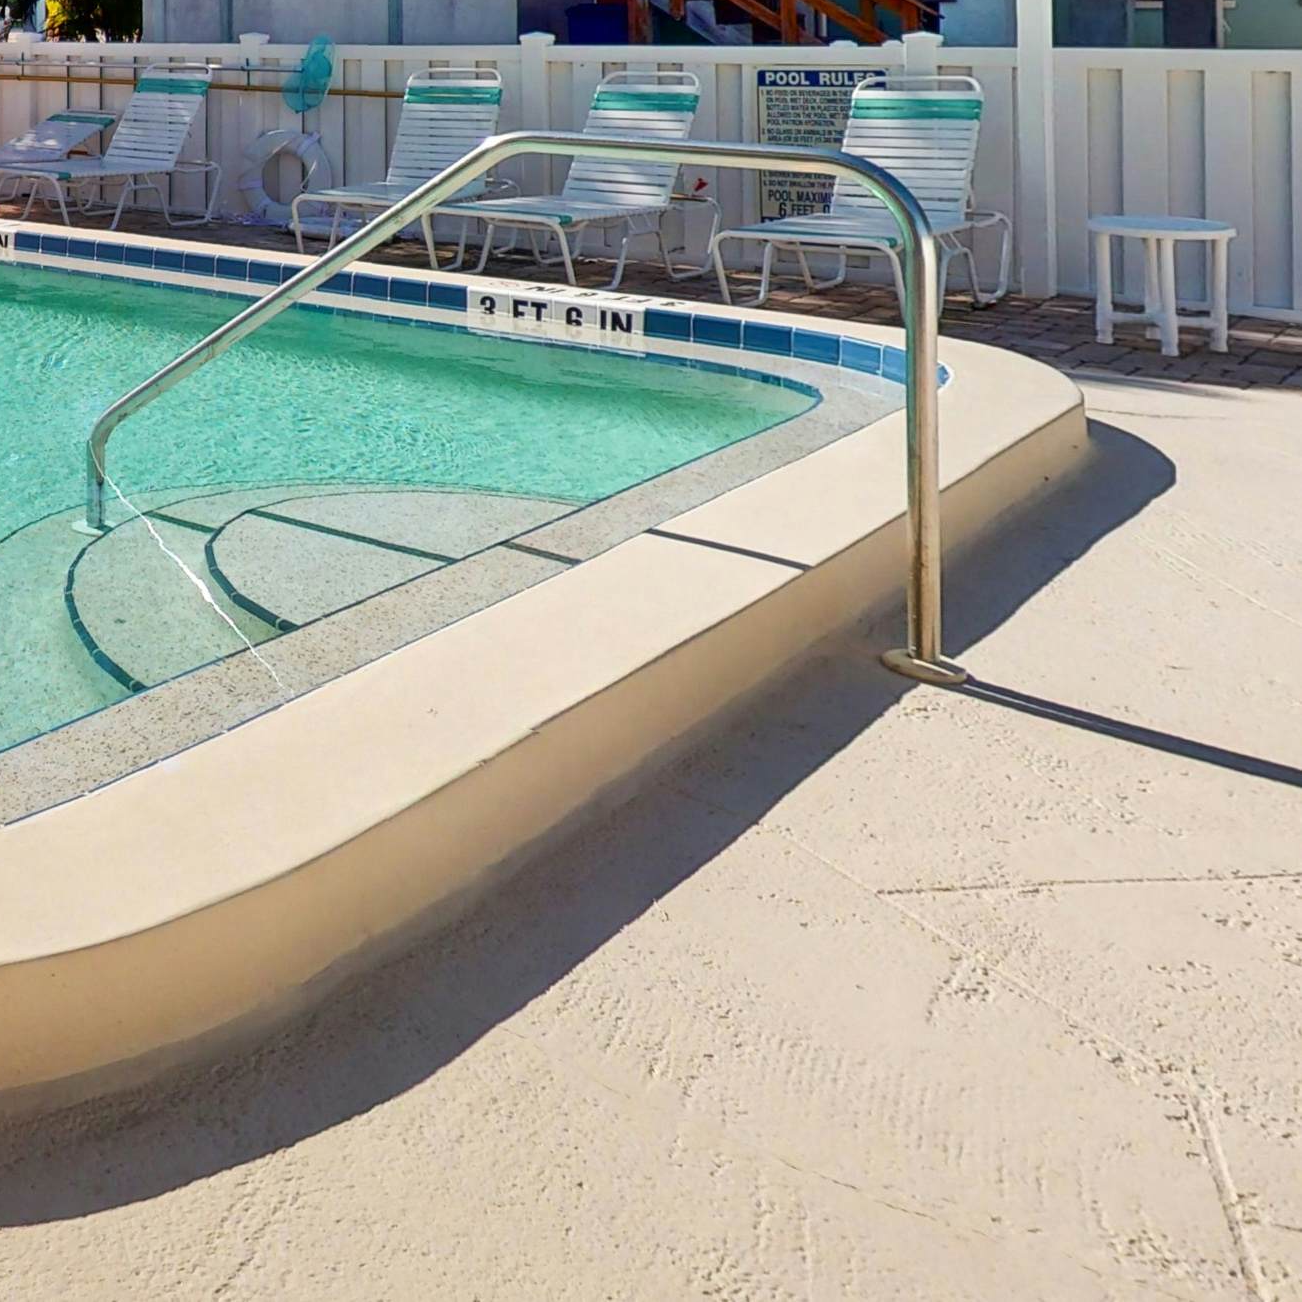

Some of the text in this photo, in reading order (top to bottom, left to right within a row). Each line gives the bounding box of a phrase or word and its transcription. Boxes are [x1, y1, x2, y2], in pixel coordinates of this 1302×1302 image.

[765, 72, 810, 85] POOL
[768, 190, 795, 202] POOL
[779, 202, 787, 218] 6
[791, 204, 815, 216] FEET
[480, 295, 632, 333] 3 FT 6 IN
